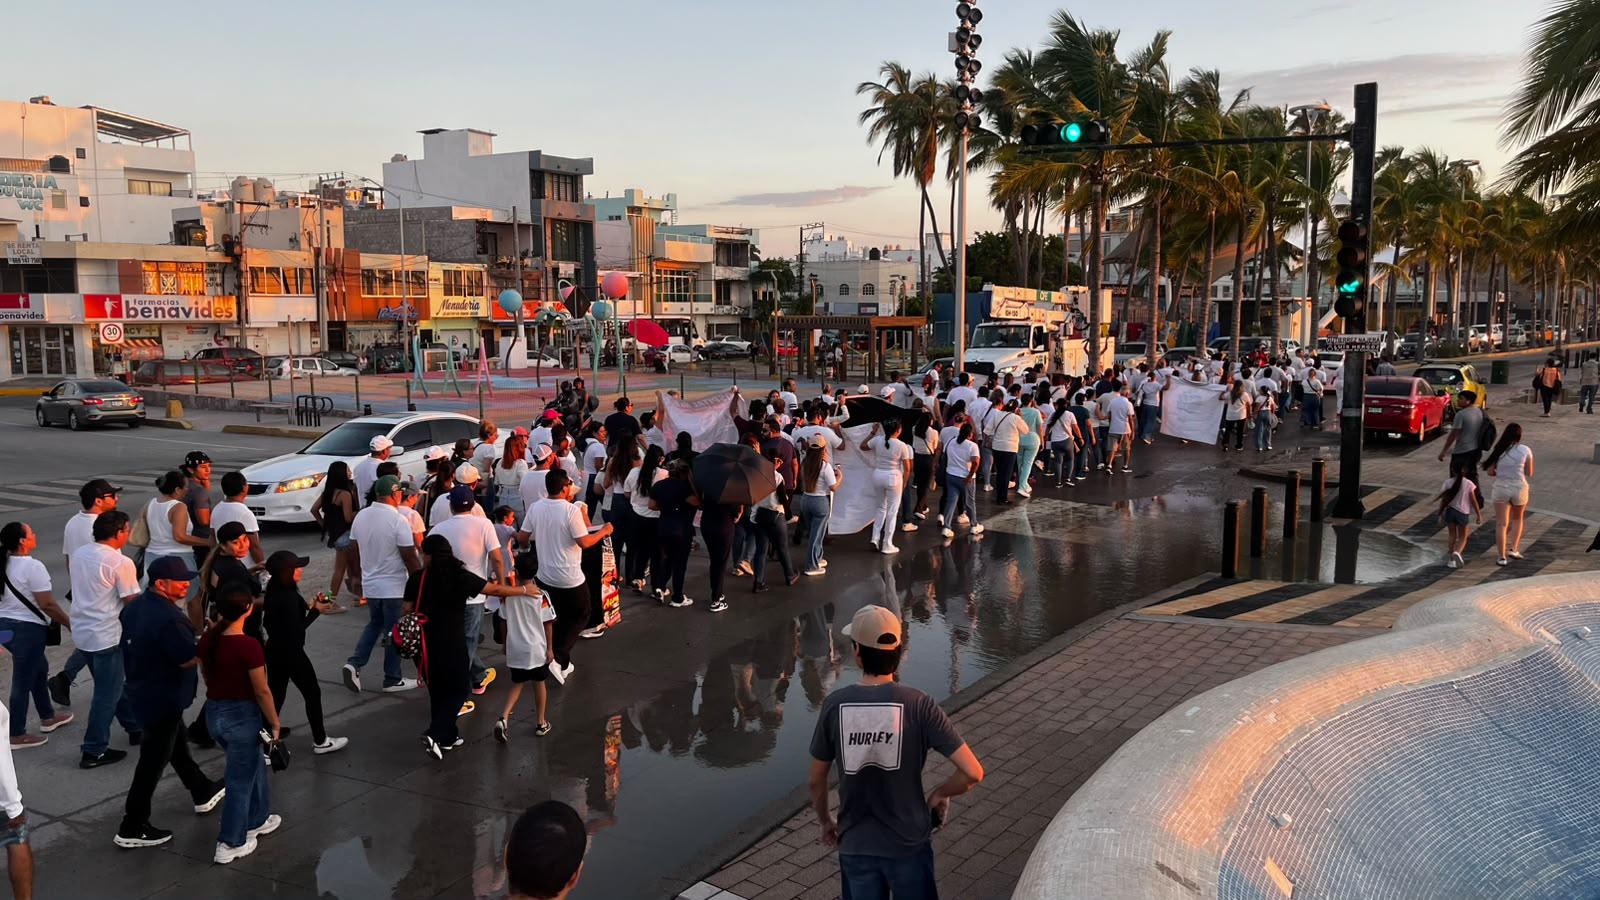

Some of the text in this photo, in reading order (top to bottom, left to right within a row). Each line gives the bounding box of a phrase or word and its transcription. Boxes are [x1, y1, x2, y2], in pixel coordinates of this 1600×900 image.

[17, 199, 44, 211] WC
[133, 298, 180, 306] farmacias
[125, 300, 233, 319] benavides
[107, 327, 118, 336] 30
